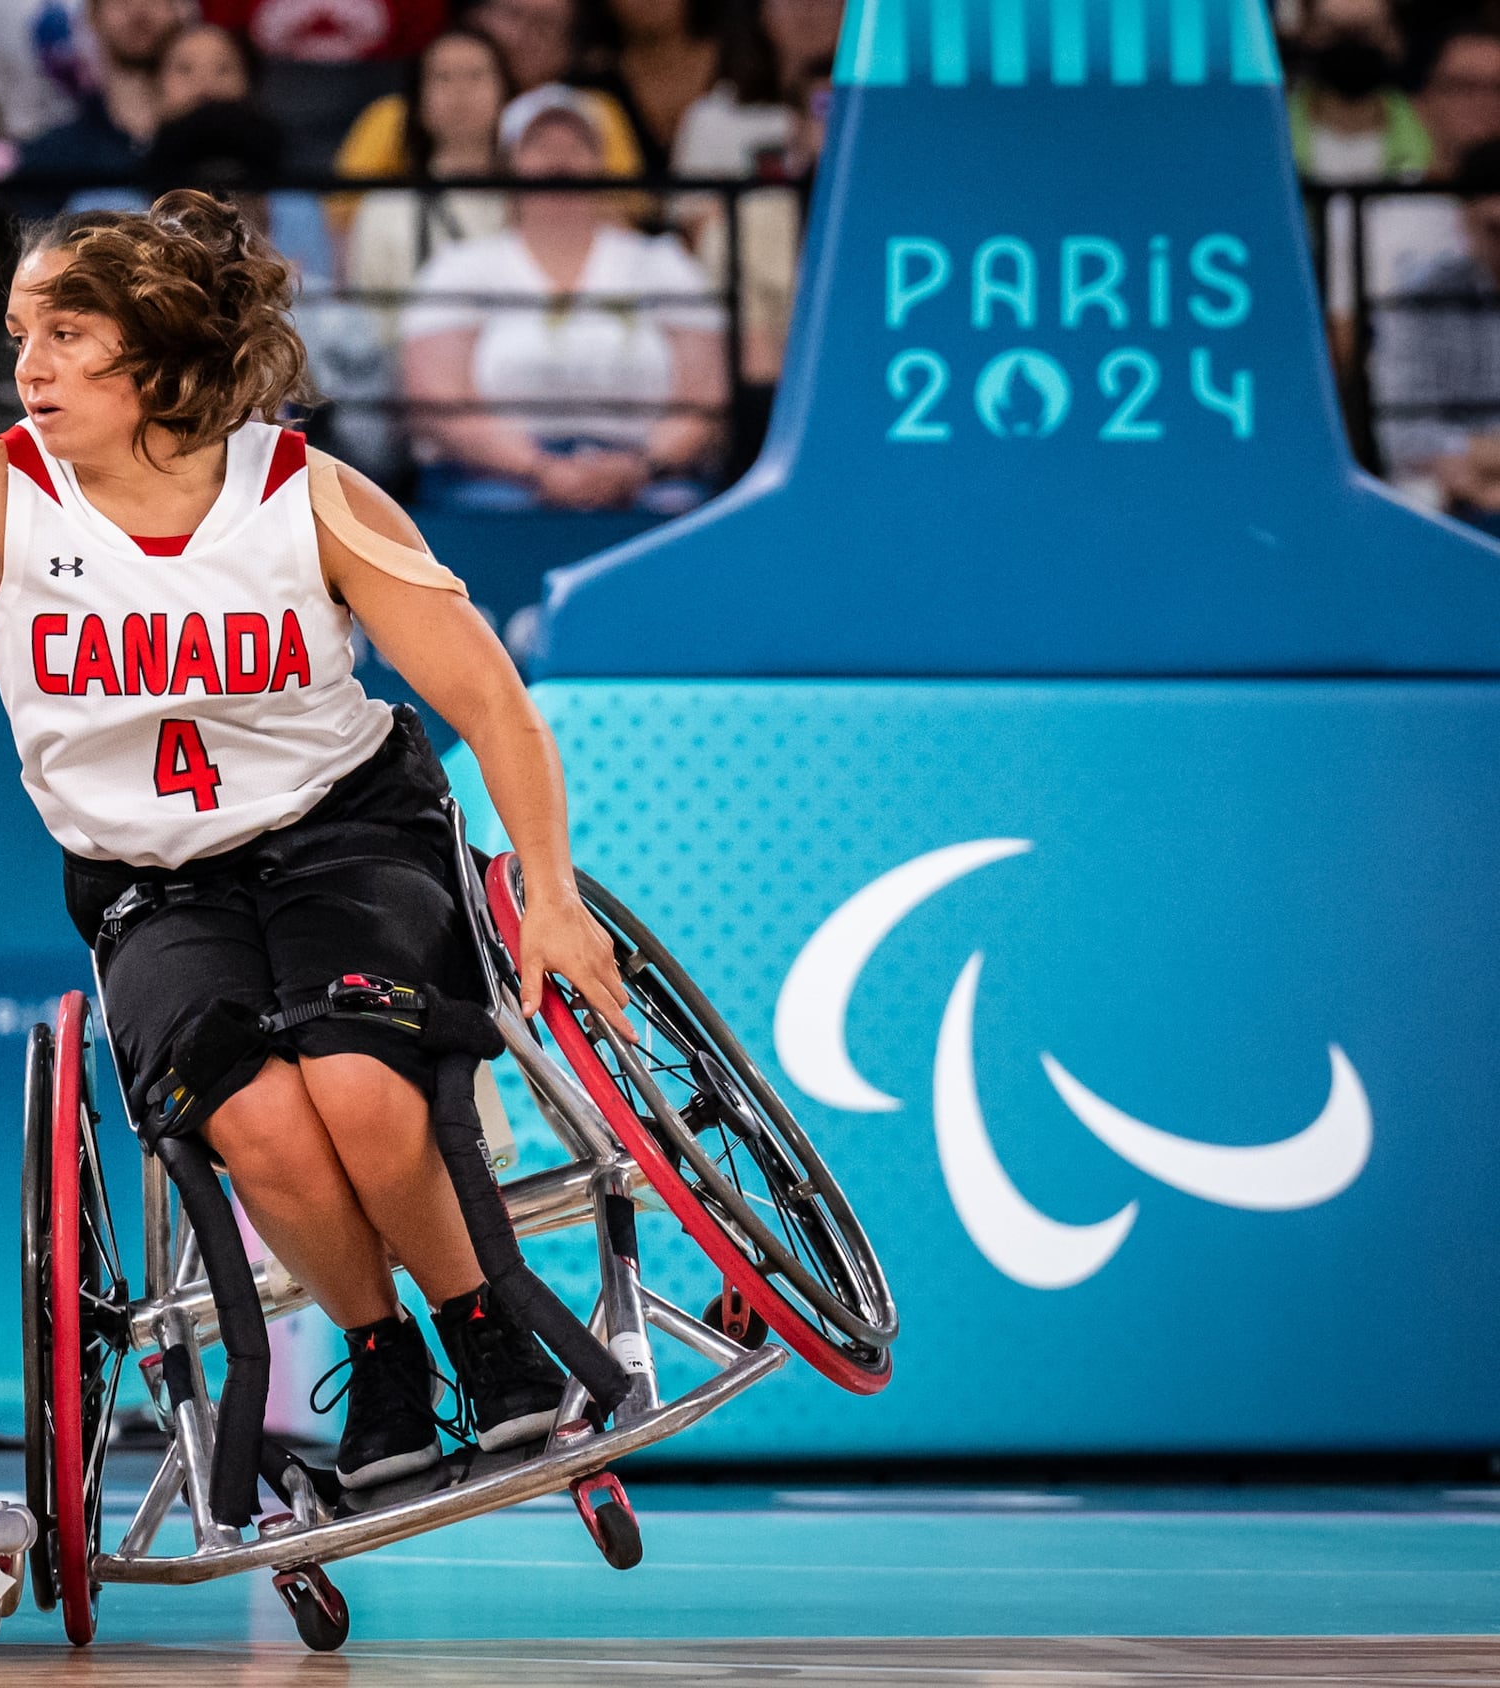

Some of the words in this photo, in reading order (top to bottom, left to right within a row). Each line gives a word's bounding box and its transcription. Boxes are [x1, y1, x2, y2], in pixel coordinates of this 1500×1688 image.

[886, 347, 1254, 440] 2024
[32, 608, 311, 696] CANADA
[153, 718, 221, 812] 4
